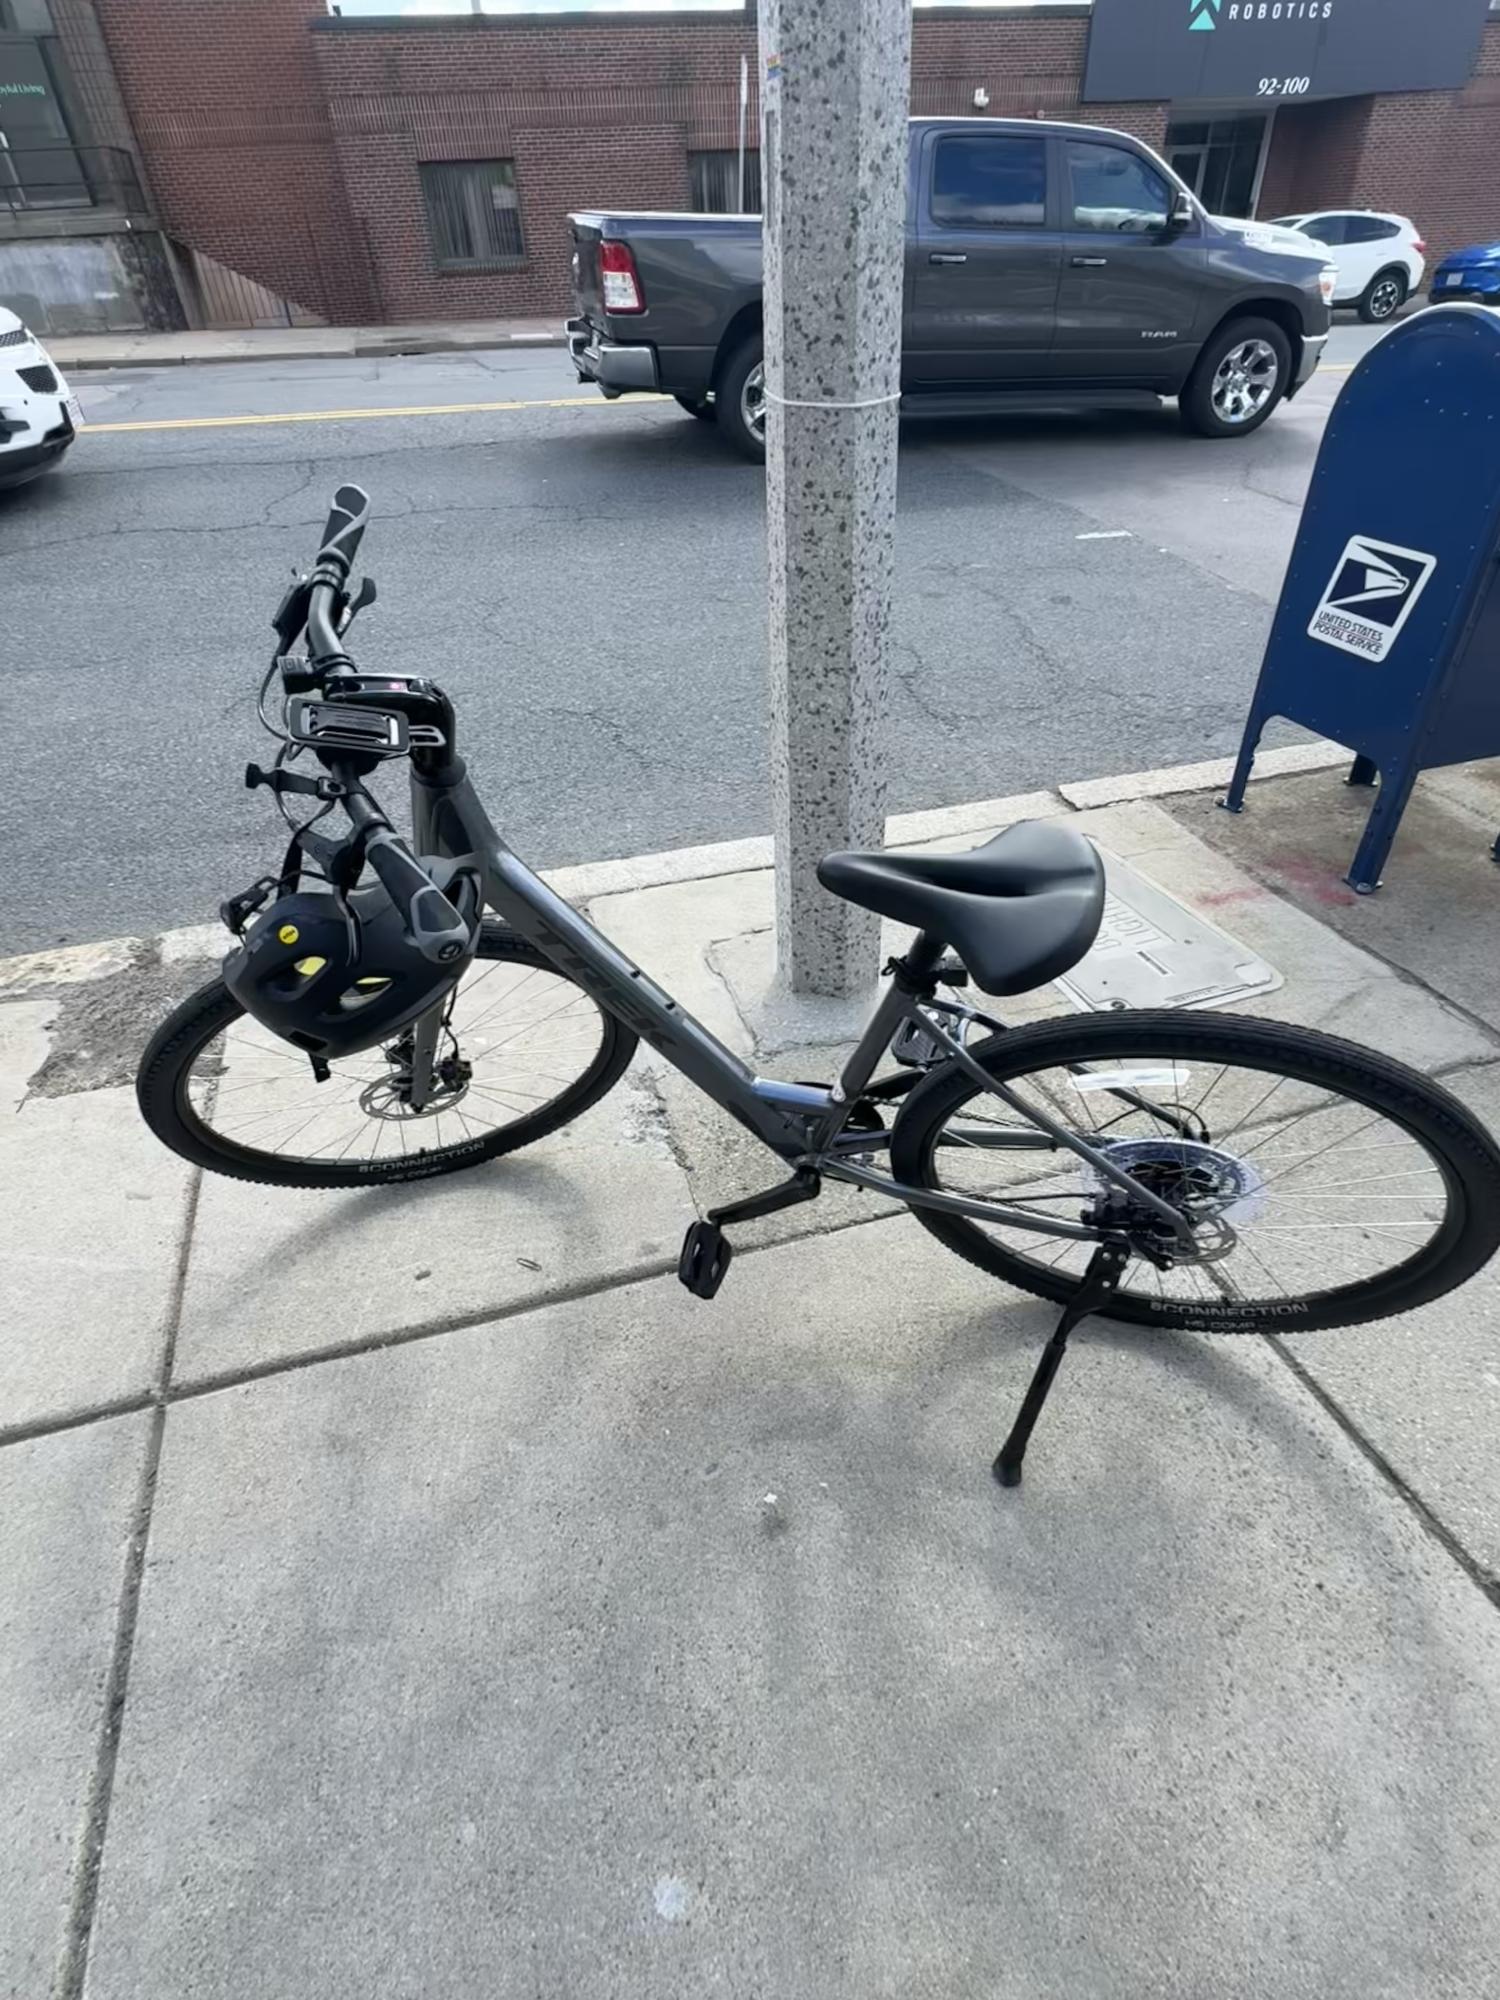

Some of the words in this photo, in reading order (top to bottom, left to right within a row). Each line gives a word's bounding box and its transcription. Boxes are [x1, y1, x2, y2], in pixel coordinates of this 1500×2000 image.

[1228, 2, 1333, 20] ROBOTICS
[1255, 76, 1311, 96] 92-100
[1141, 330, 1178, 338] RAM
[1313, 620, 1345, 642] POSTAL
[1345, 632, 1383, 656] SERVICE
[1318, 610, 1352, 630] UNITED
[1350, 622, 1384, 642] STATES
[532, 919, 678, 1048] TREK
